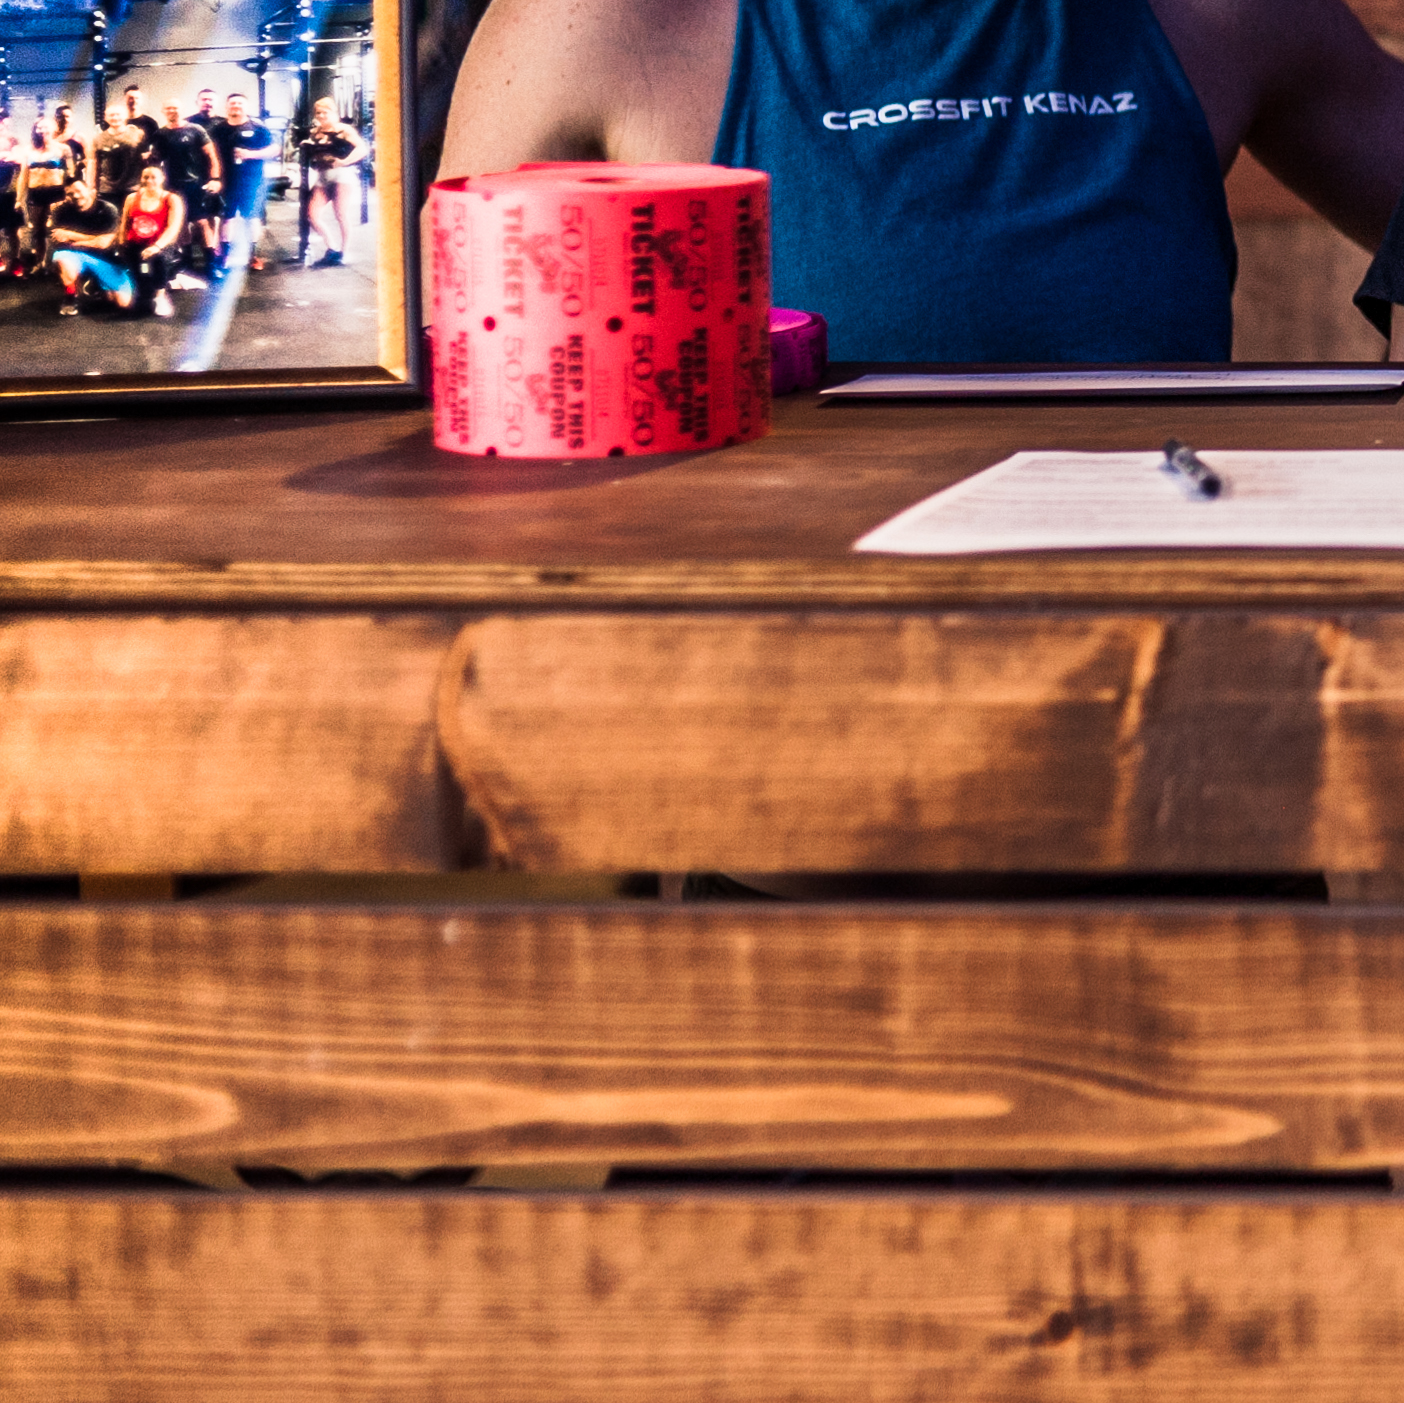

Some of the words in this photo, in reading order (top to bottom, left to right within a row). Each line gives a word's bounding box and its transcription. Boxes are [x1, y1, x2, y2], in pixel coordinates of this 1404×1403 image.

[822, 96, 1012, 130] CROSSFIT
[1023, 92, 1138, 116] KENAZ
[503, 204, 524, 318] TICKET
[560, 204, 584, 317] 50/50
[631, 203, 655, 316] TICKET
[688, 199, 708, 312] 50/50
[504, 337, 524, 448] 50/50
[550, 347, 565, 439] COUPON
[568, 335, 584, 392] KEEP
[632, 334, 654, 447] 50/50
[693, 327, 708, 383] KEEP
[569, 401, 585, 449] THIS
[695, 394, 709, 442] THIS
